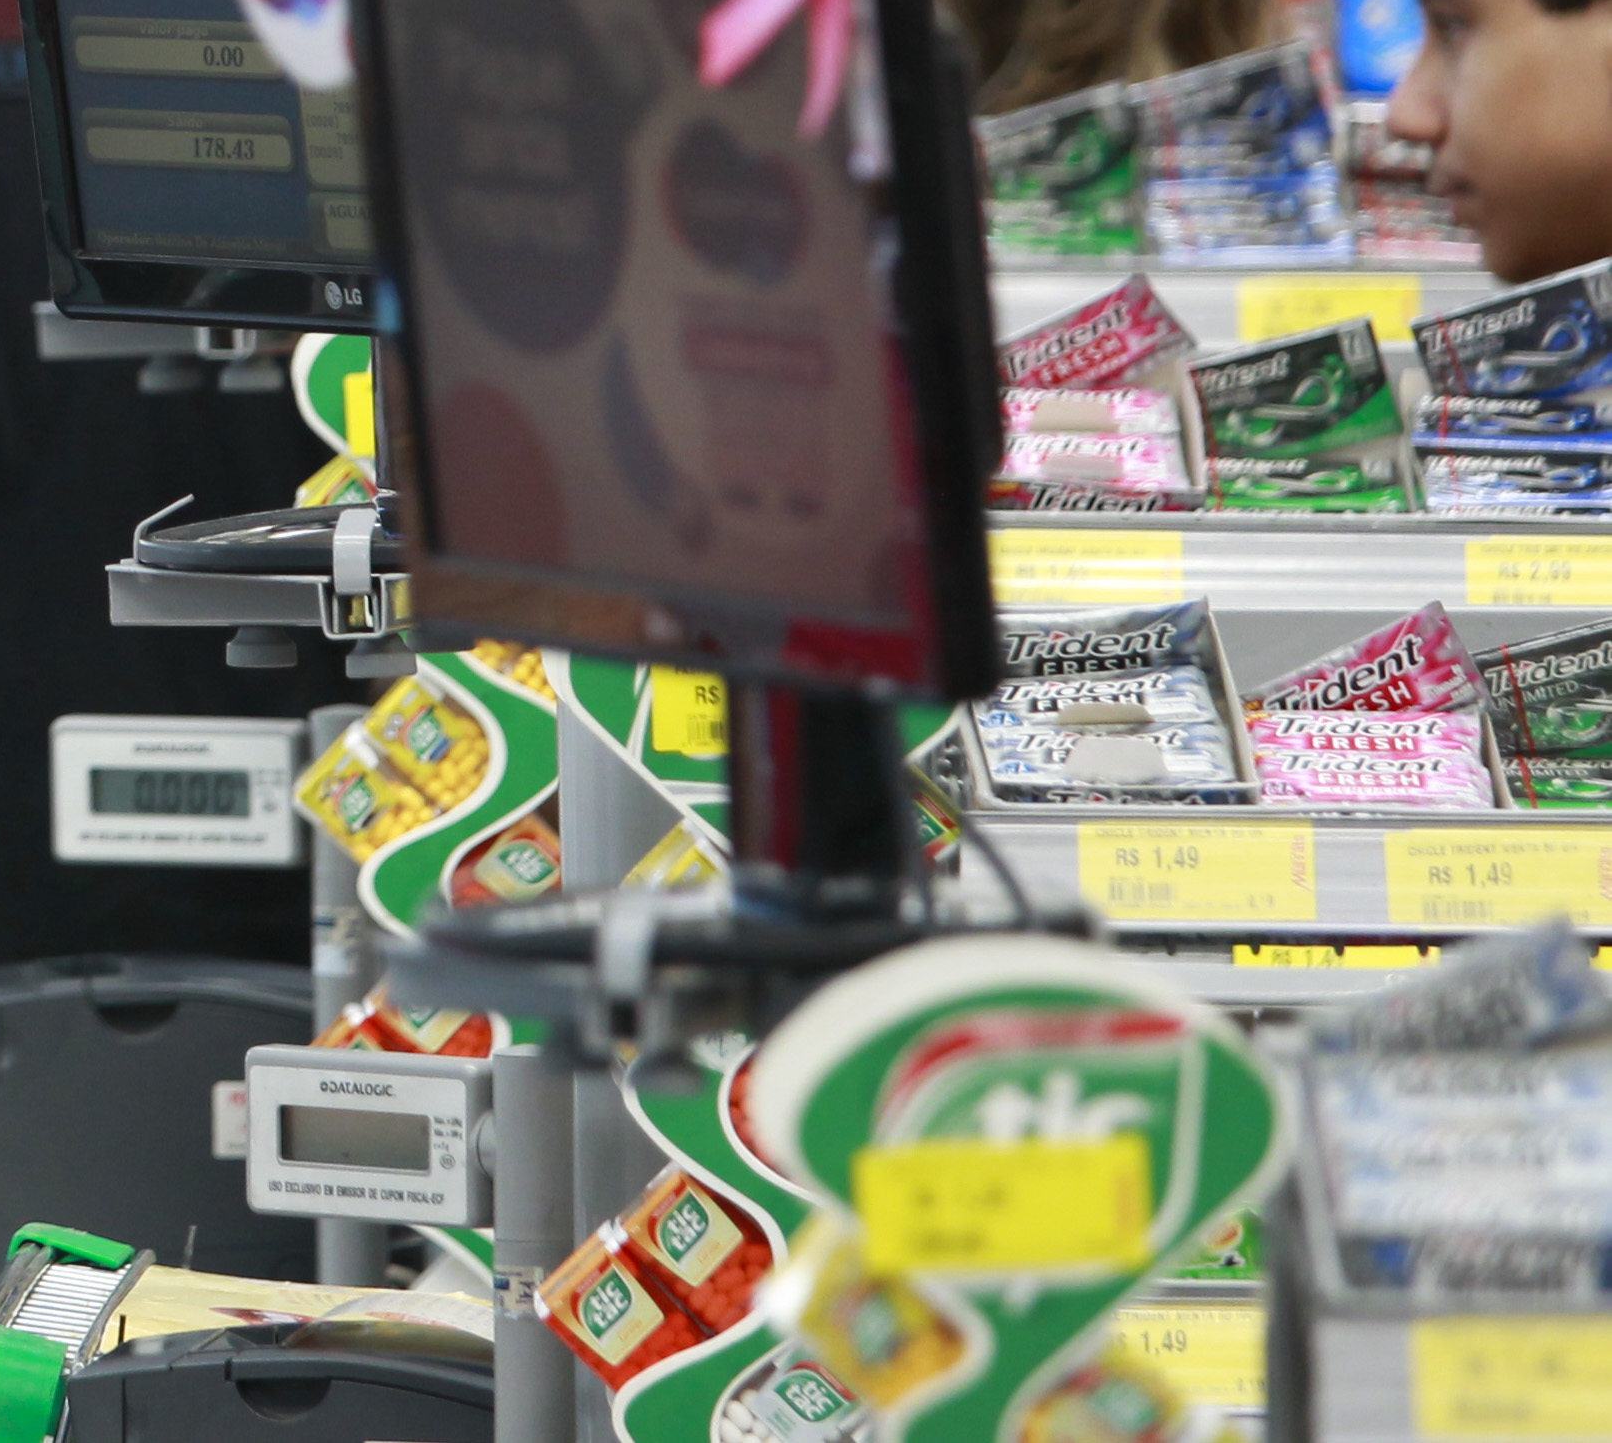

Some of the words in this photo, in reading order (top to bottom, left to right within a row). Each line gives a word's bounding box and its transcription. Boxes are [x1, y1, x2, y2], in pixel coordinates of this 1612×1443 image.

[203, 45, 245, 67] 0.00
[193, 137, 255, 161] 178.43
[344, 287, 363, 306] LG
[1005, 622, 1177, 665] Trident
[1043, 655, 1143, 677] FRESH
[1264, 633, 1425, 711] Trident
[1000, 673, 1173, 704] Trident
[1271, 714, 1447, 737] Trident
[1312, 736, 1415, 751] FRESH
[1279, 752, 1451, 773] Trident
[1317, 772, 1421, 786] FRESH
[1153, 845, 1200, 871] 1,49
[1465, 862, 1514, 888] 1,49
[329, 1081, 394, 1098] DATALOGIC
[268, 1180, 283, 1192] USO
[285, 1181, 322, 1196] EXCLUSIVO
[324, 1183, 335, 1196] EM
[337, 1184, 367, 1199] EMISSOR
[368, 1187, 378, 1200] DE
[380, 1187, 405, 1202] CUPOM
[665, 1203, 699, 1233] tic
[670, 1213, 707, 1253] tac
[588, 1279, 619, 1312] tic
[592, 1291, 630, 1330] tac
[1141, 1329, 1188, 1355] 1,49
